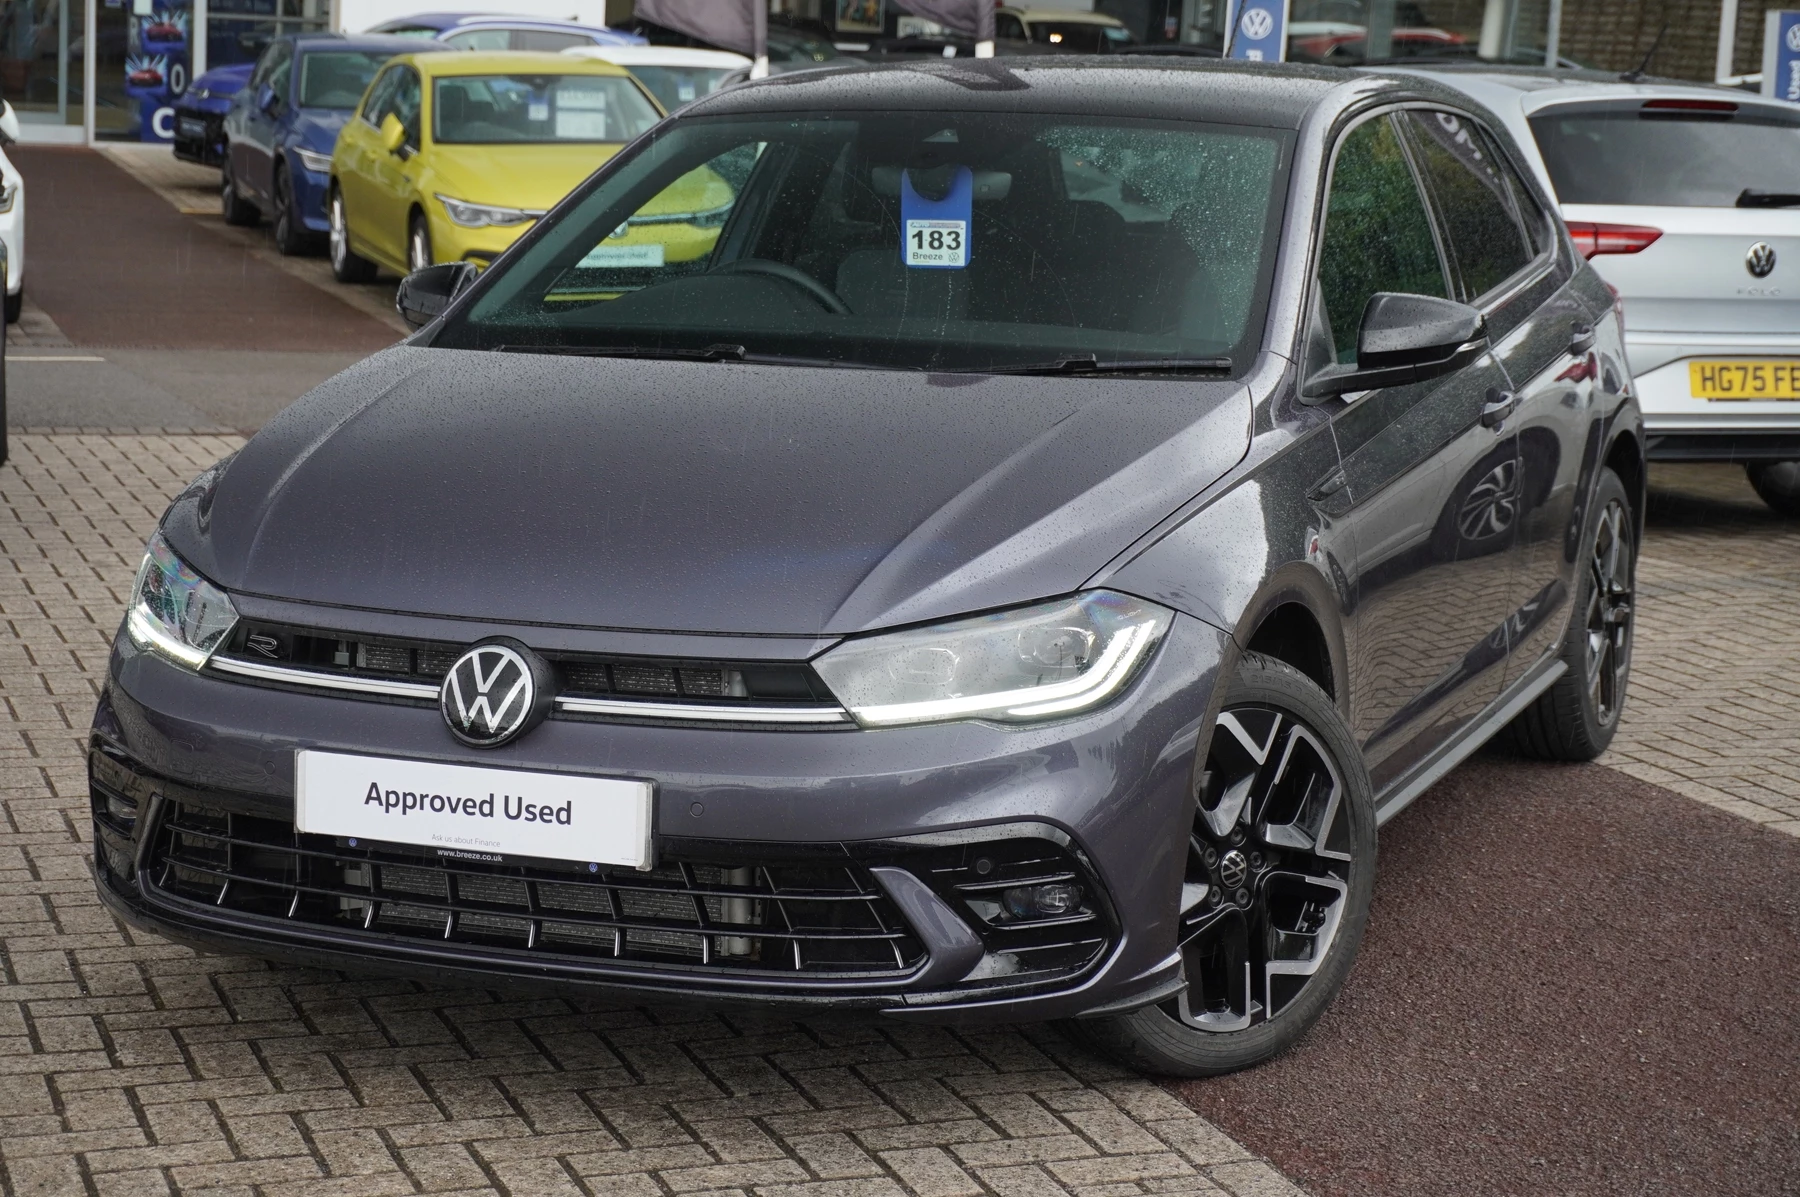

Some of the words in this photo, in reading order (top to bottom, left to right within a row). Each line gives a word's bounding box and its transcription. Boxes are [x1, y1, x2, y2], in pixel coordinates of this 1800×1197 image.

[912, 230, 961, 250] 183
[912, 252, 944, 261] Breeze
[1700, 366, 1767, 392] HG75
[363, 781, 495, 818] Approved
[504, 794, 572, 826] Used
[431, 834, 443, 842] Ask
[453, 836, 473, 845] about
[474, 838, 501, 848] Finance
[436, 849, 503, 862] www.breeze.co.uk
